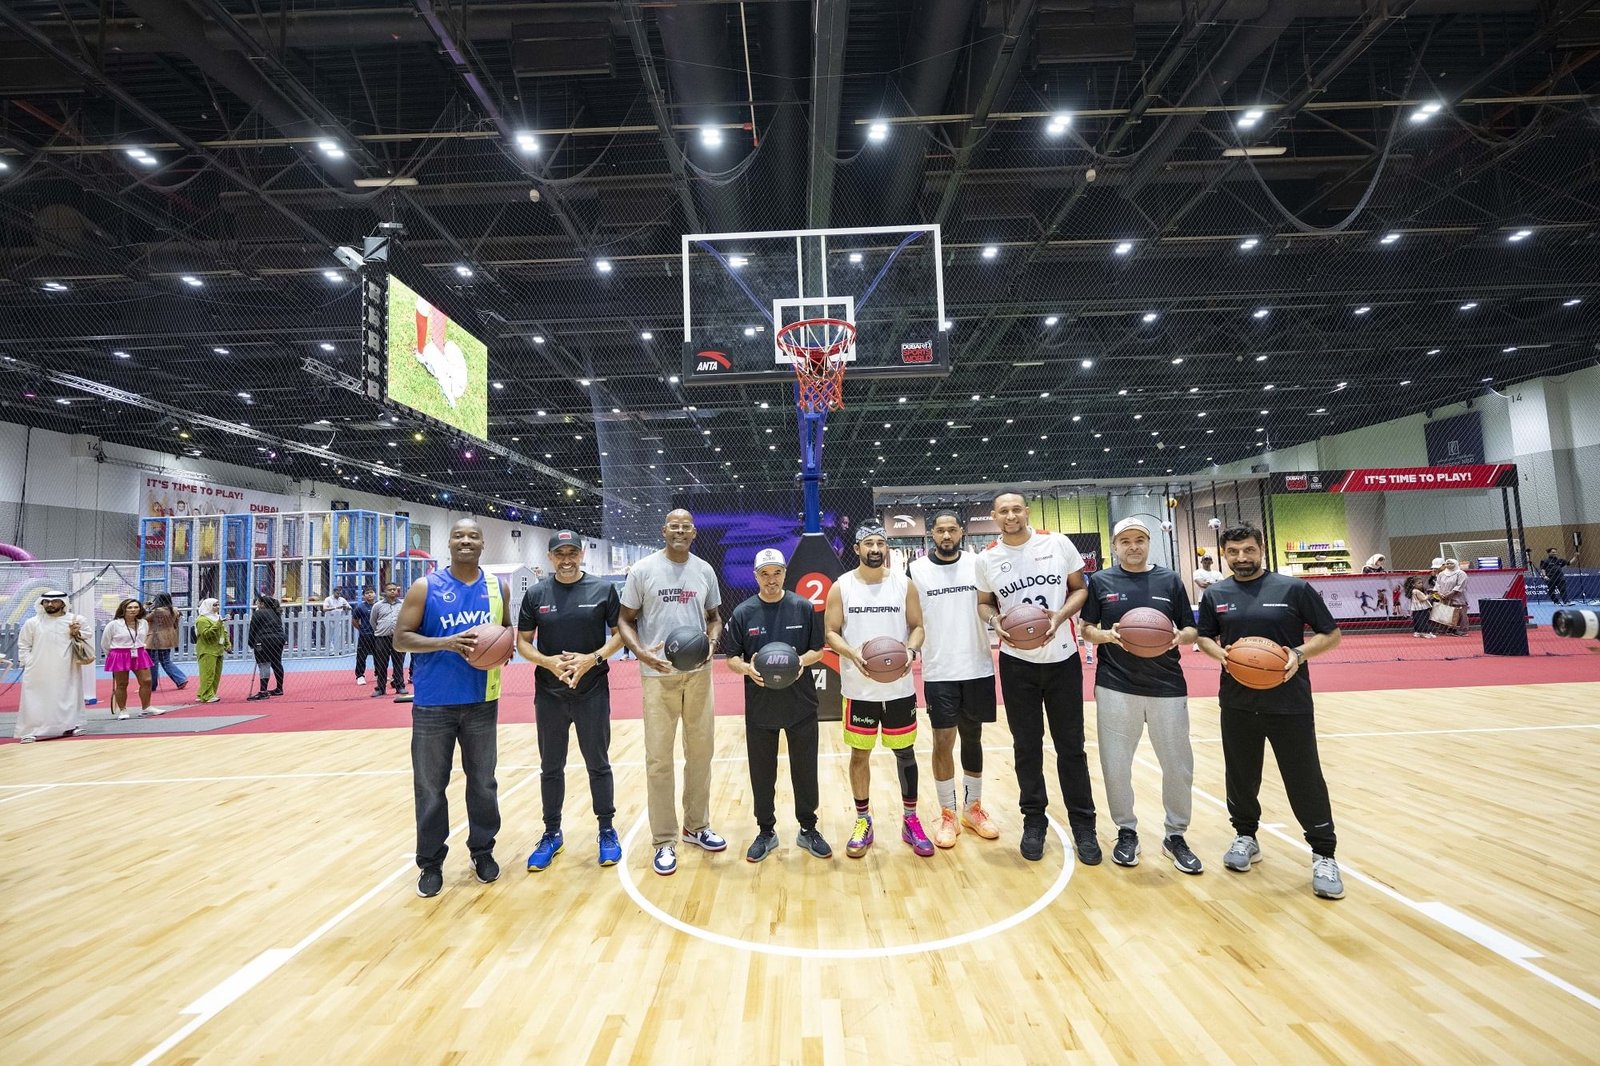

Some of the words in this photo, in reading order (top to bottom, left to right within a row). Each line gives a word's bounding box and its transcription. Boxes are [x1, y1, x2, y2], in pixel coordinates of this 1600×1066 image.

[696, 361, 718, 371] ANTA
[1511, 393, 1522, 403] 14
[1364, 475, 1386, 485] IT'S
[1388, 474, 1417, 484] TIME
[1418, 473, 1435, 483] TO
[1436, 472, 1472, 482] PLAY!
[146, 478, 169, 489] IT'S
[171, 482, 198, 494] TIME
[199, 486, 214, 496] TO
[215, 489, 244, 501] PLAY!
[893, 521, 908, 529] ANTA
[999, 574, 1062, 598] BULLDOGS
[658, 588, 682, 596] NEVER
[806, 580, 824, 605] 2
[662, 595, 681, 603] QUIT
[766, 655, 789, 665] ANTA
